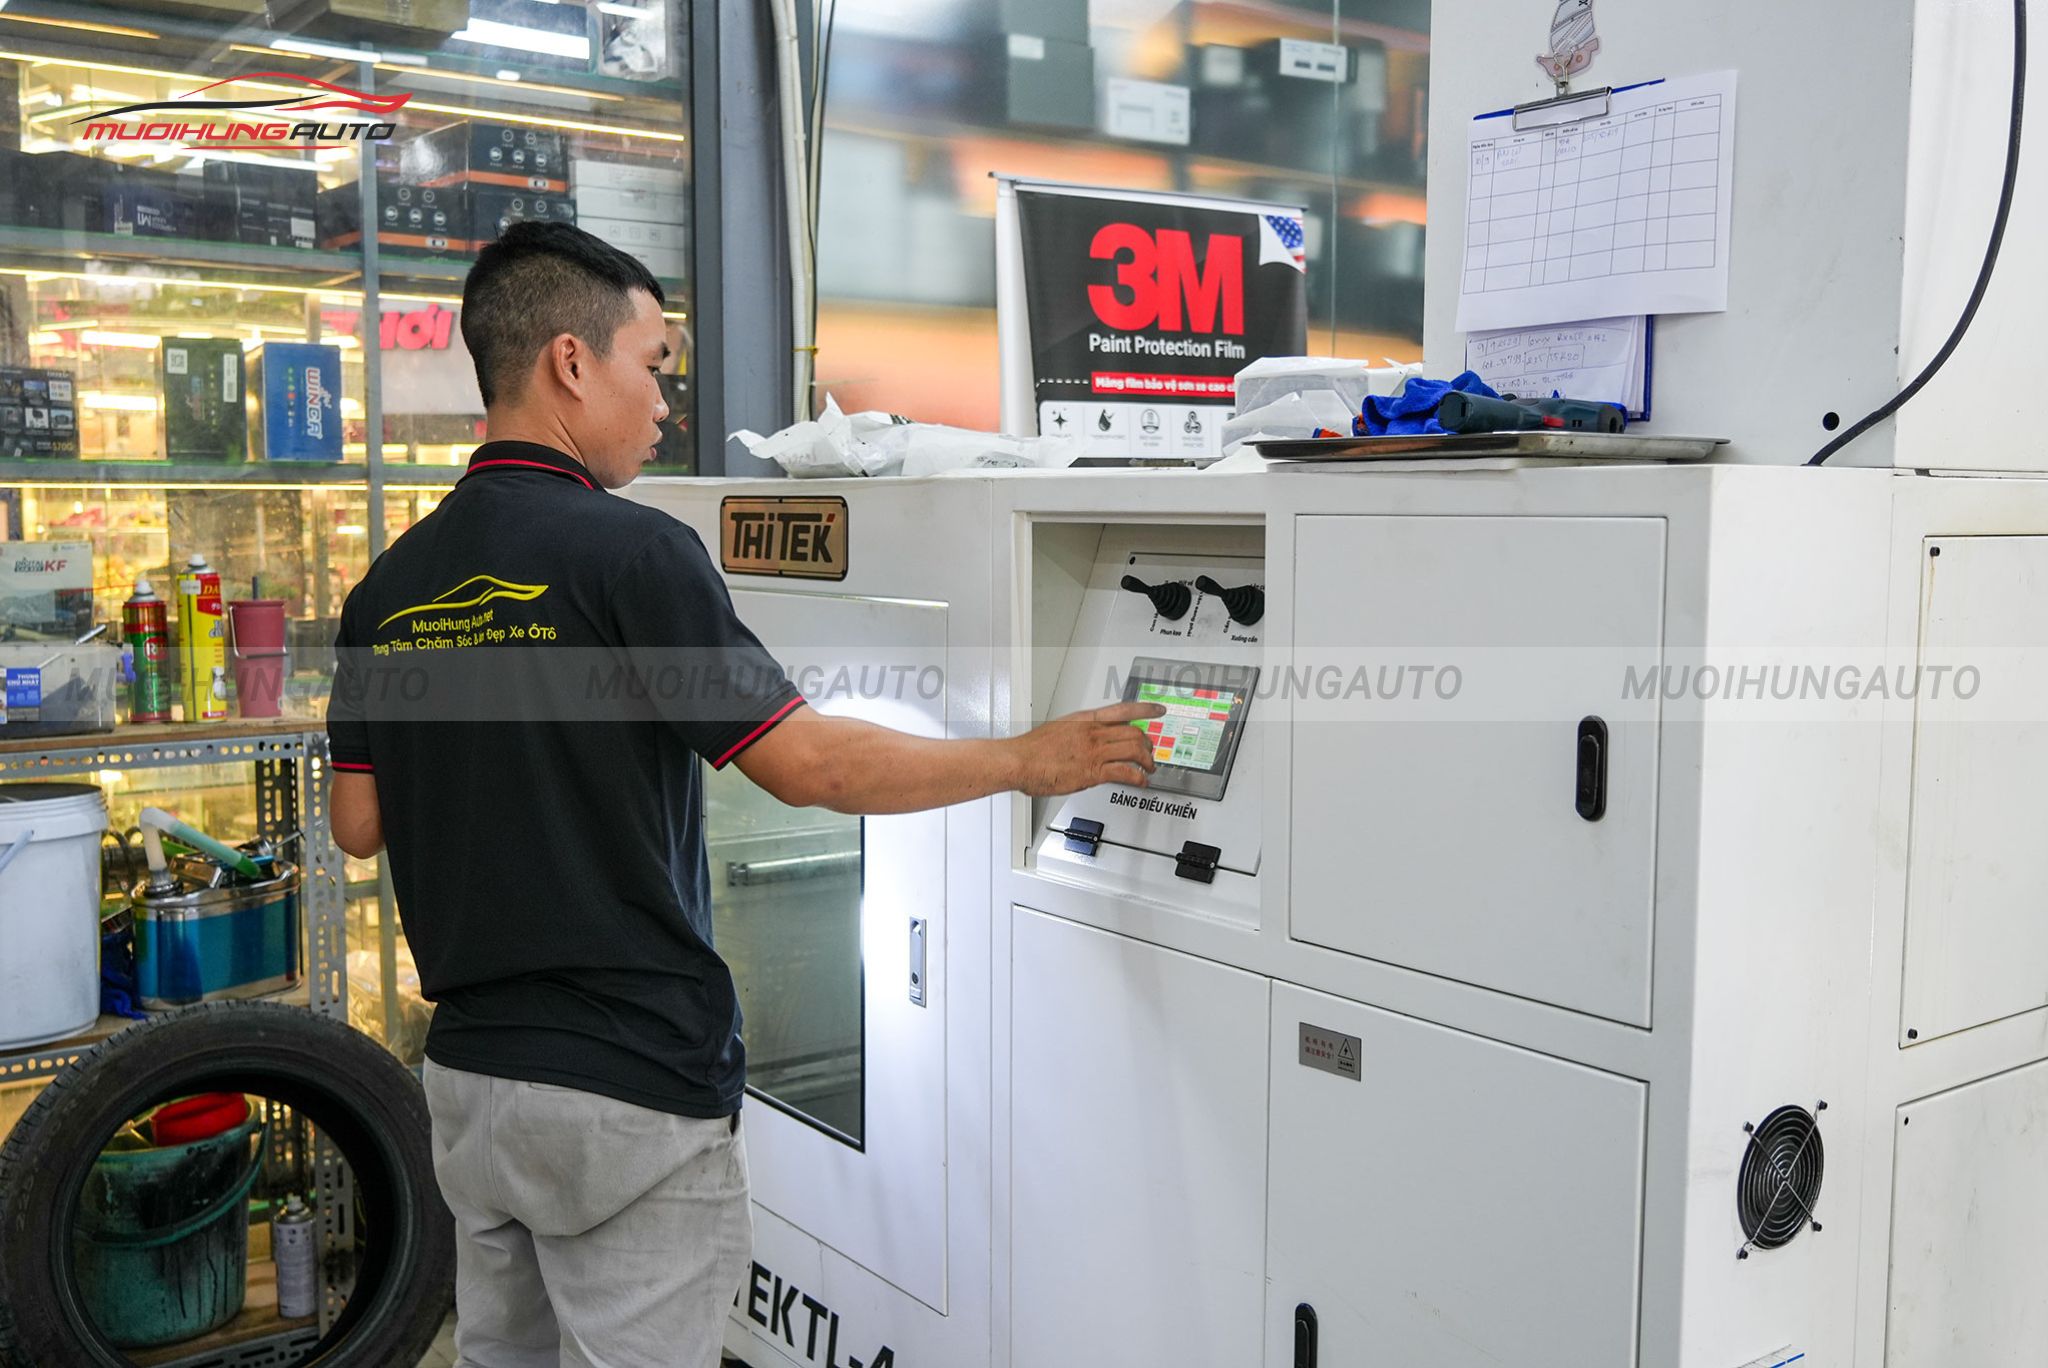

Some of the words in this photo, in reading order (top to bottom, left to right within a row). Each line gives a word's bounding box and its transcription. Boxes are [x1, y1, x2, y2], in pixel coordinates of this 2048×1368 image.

[1087, 222, 1245, 336] 3M
[1088, 333, 1132, 354] Paint
[1134, 335, 1212, 358] Protection
[1215, 340, 1246, 360] Film
[305, 366, 322, 439] WINCA
[44, 560, 67, 572] KF
[390, 638, 413, 652] Tâm
[415, 636, 454, 650] Chăm
[456, 633, 472, 648] Sóc
[486, 628, 506, 644] Đẹp
[509, 625, 525, 639] Xe
[411, 617, 470, 634] MuoiHung
[1160, 628, 1173, 636] Phun
[733, 1259, 895, 1368] EKTL-
